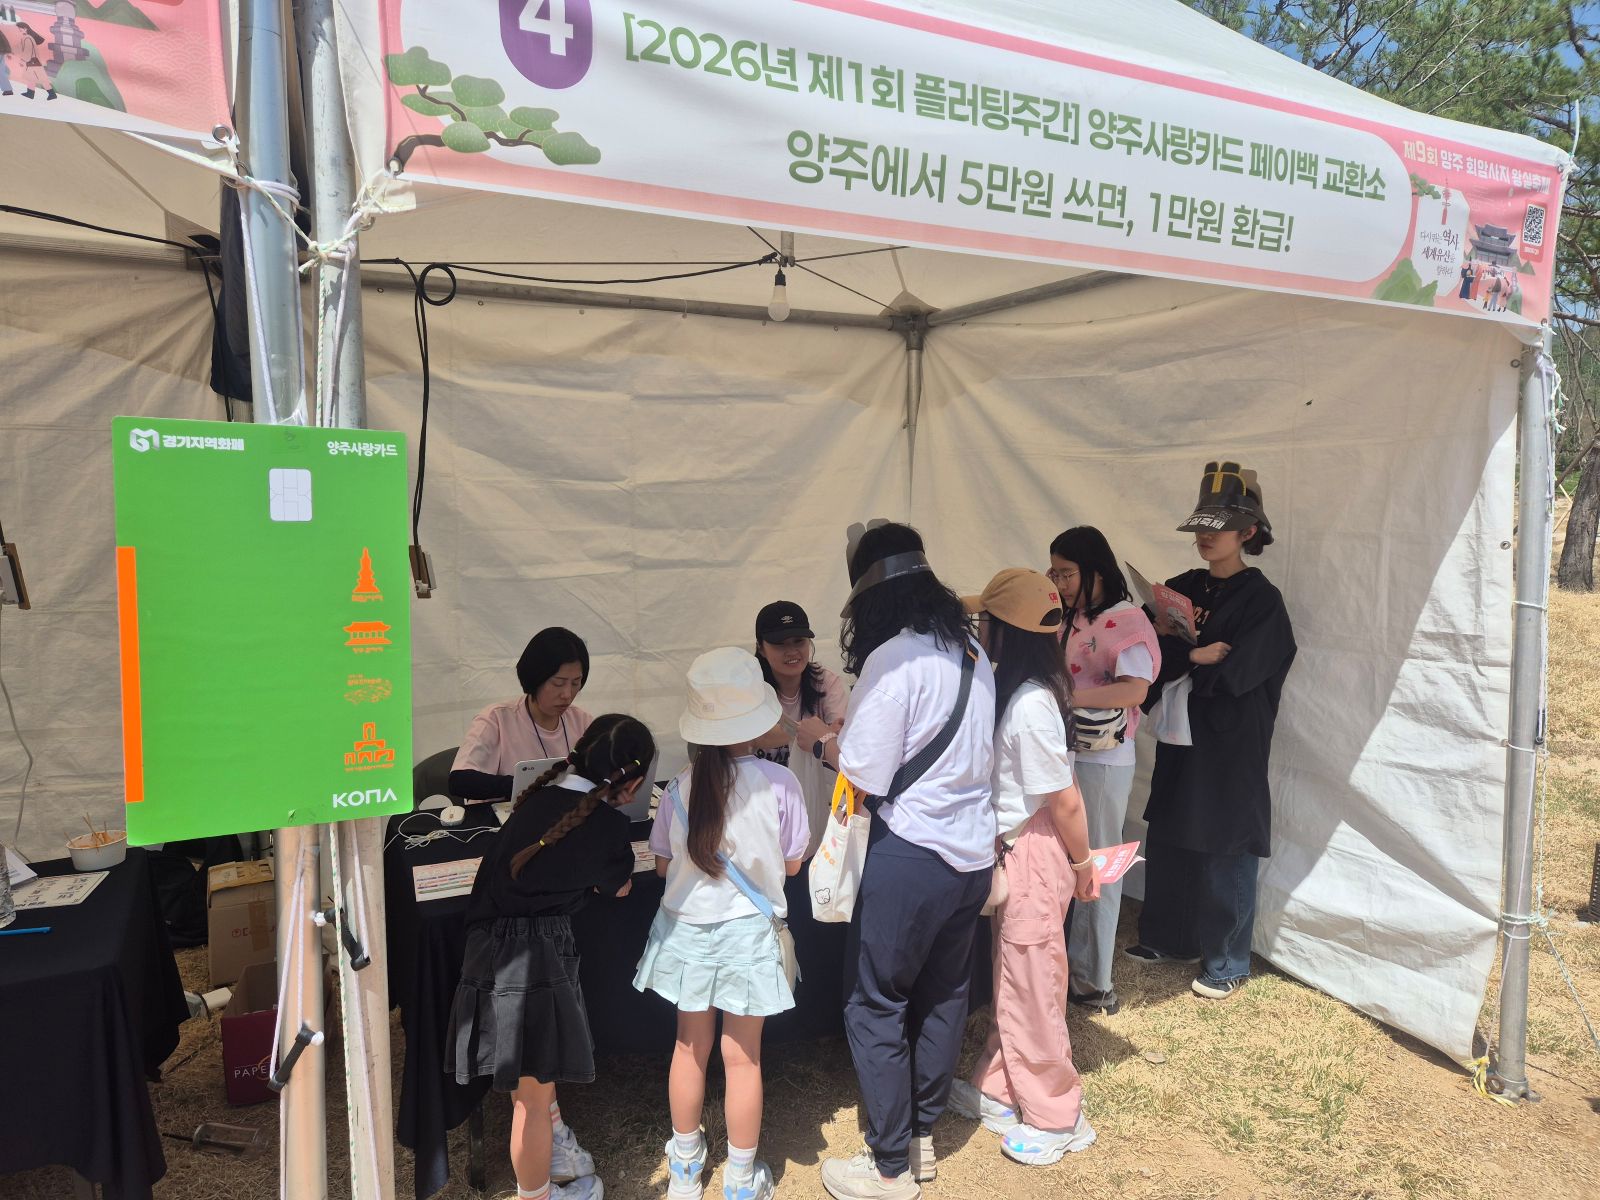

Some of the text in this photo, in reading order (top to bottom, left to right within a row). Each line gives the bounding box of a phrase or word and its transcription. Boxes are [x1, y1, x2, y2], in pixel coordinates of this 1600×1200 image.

[518, 0, 573, 56] 4
[624, 13, 1385, 201] [2026년 제1회 플러팅주간] 양주사랑카드 페이백 교환소
[787, 130, 1295, 253] 양주에서 5만원 쓰면, 1만원 환급!
[1403, 140, 1551, 195] 제9회 양주 회암사지 왕실축제
[162, 434, 245, 451] 경기지역화폐
[327, 440, 398, 457] 양주사랑카드
